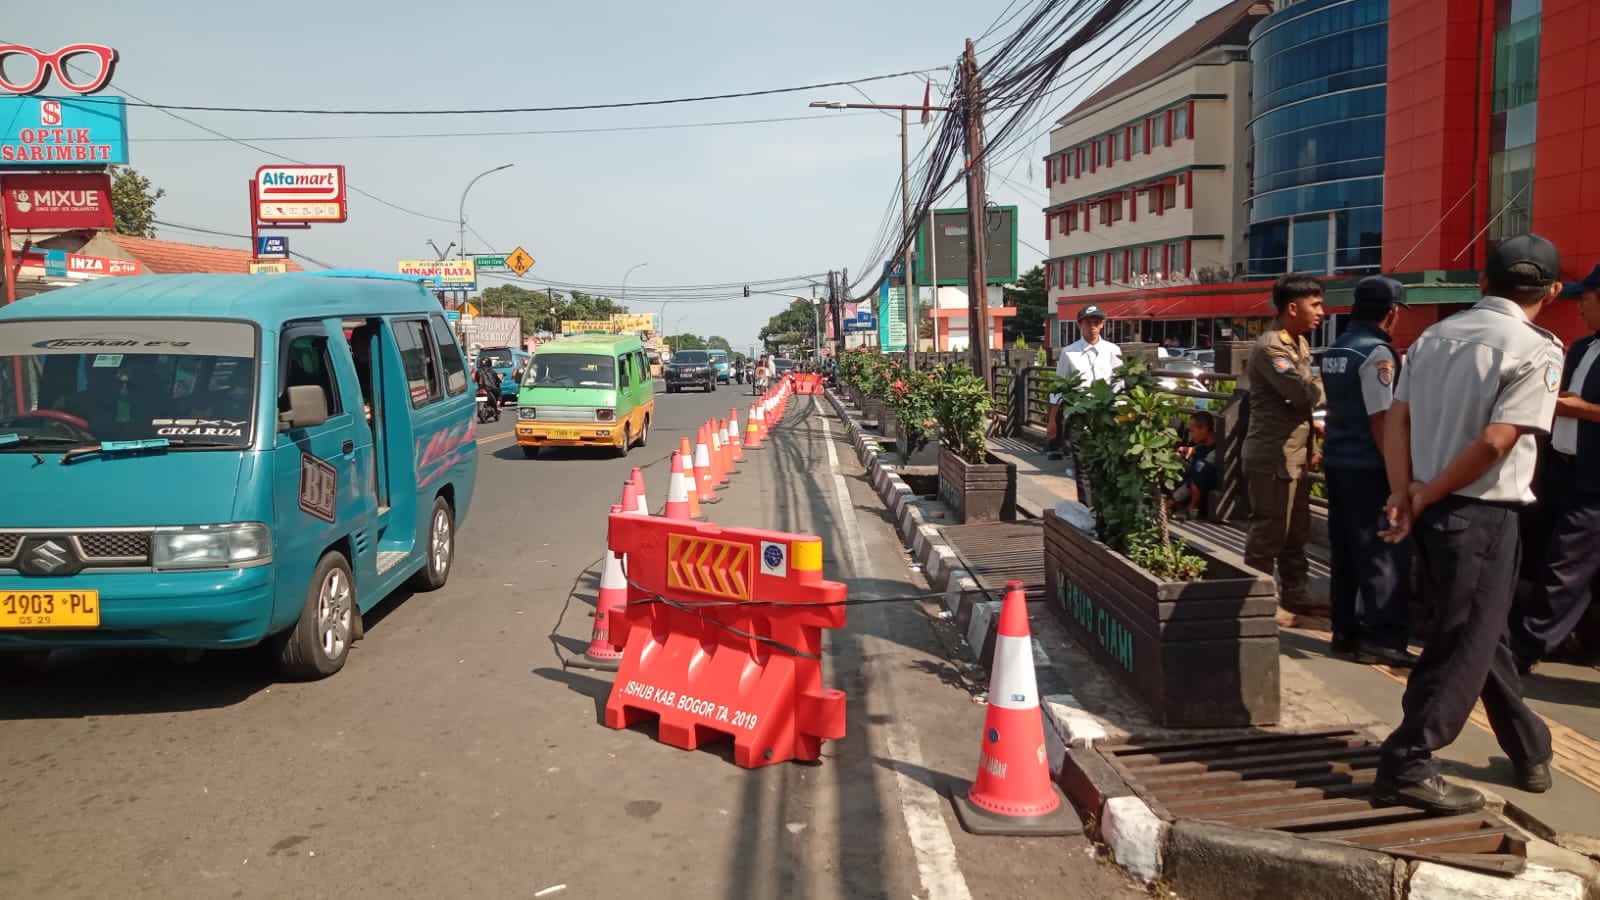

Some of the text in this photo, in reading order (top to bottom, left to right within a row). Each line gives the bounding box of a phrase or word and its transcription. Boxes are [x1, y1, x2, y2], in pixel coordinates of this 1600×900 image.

[42, 101, 60, 125] S
[20, 128, 90, 144] OPTIK
[2, 145, 111, 161] SARIMBIT
[263, 172, 334, 185] Alfamart
[34, 190, 99, 207] MIXUE
[71, 257, 103, 270] INZA
[401, 267, 442, 276] MINANG
[157, 427, 242, 437] CISARUA
[70, 594, 94, 614] PL
[619, 680, 758, 730] ISHUB KAB. BOGOR TA. 2019
